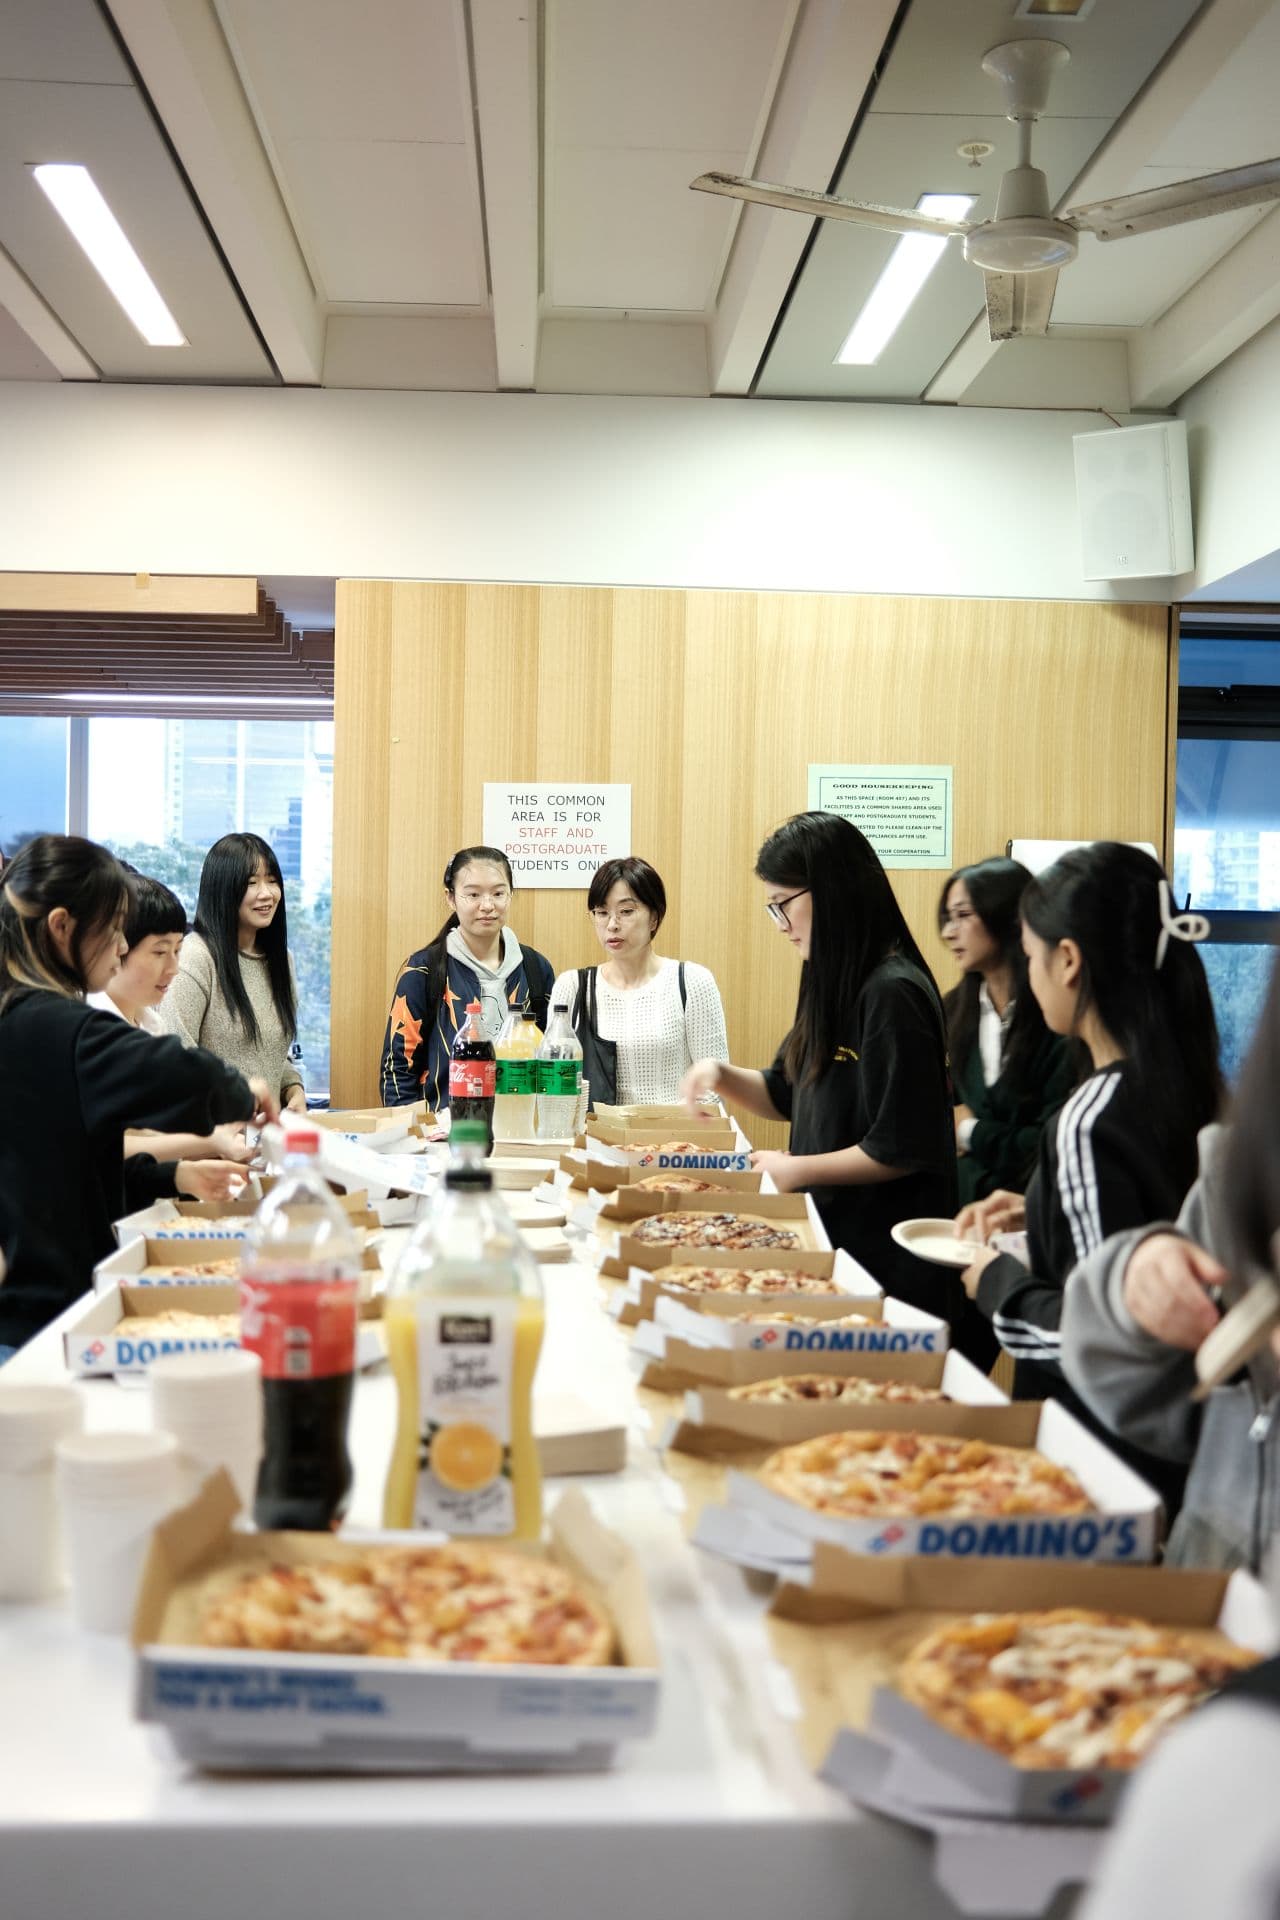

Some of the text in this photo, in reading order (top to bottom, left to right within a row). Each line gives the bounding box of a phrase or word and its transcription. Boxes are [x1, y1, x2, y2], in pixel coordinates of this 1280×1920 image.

[507, 795, 605, 806] THIS COMMON
[511, 811, 602, 822] AREA IS FOR
[519, 827, 594, 838] STAFF AND
[505, 843, 608, 855] POSTGRADUATE
[508, 860, 606, 871] TUDENTS ONL
[658, 1155, 746, 1170] DOMINO'S
[785, 1328, 935, 1352] DOMINO'S
[918, 1517, 1138, 1557] DOMINO'S
